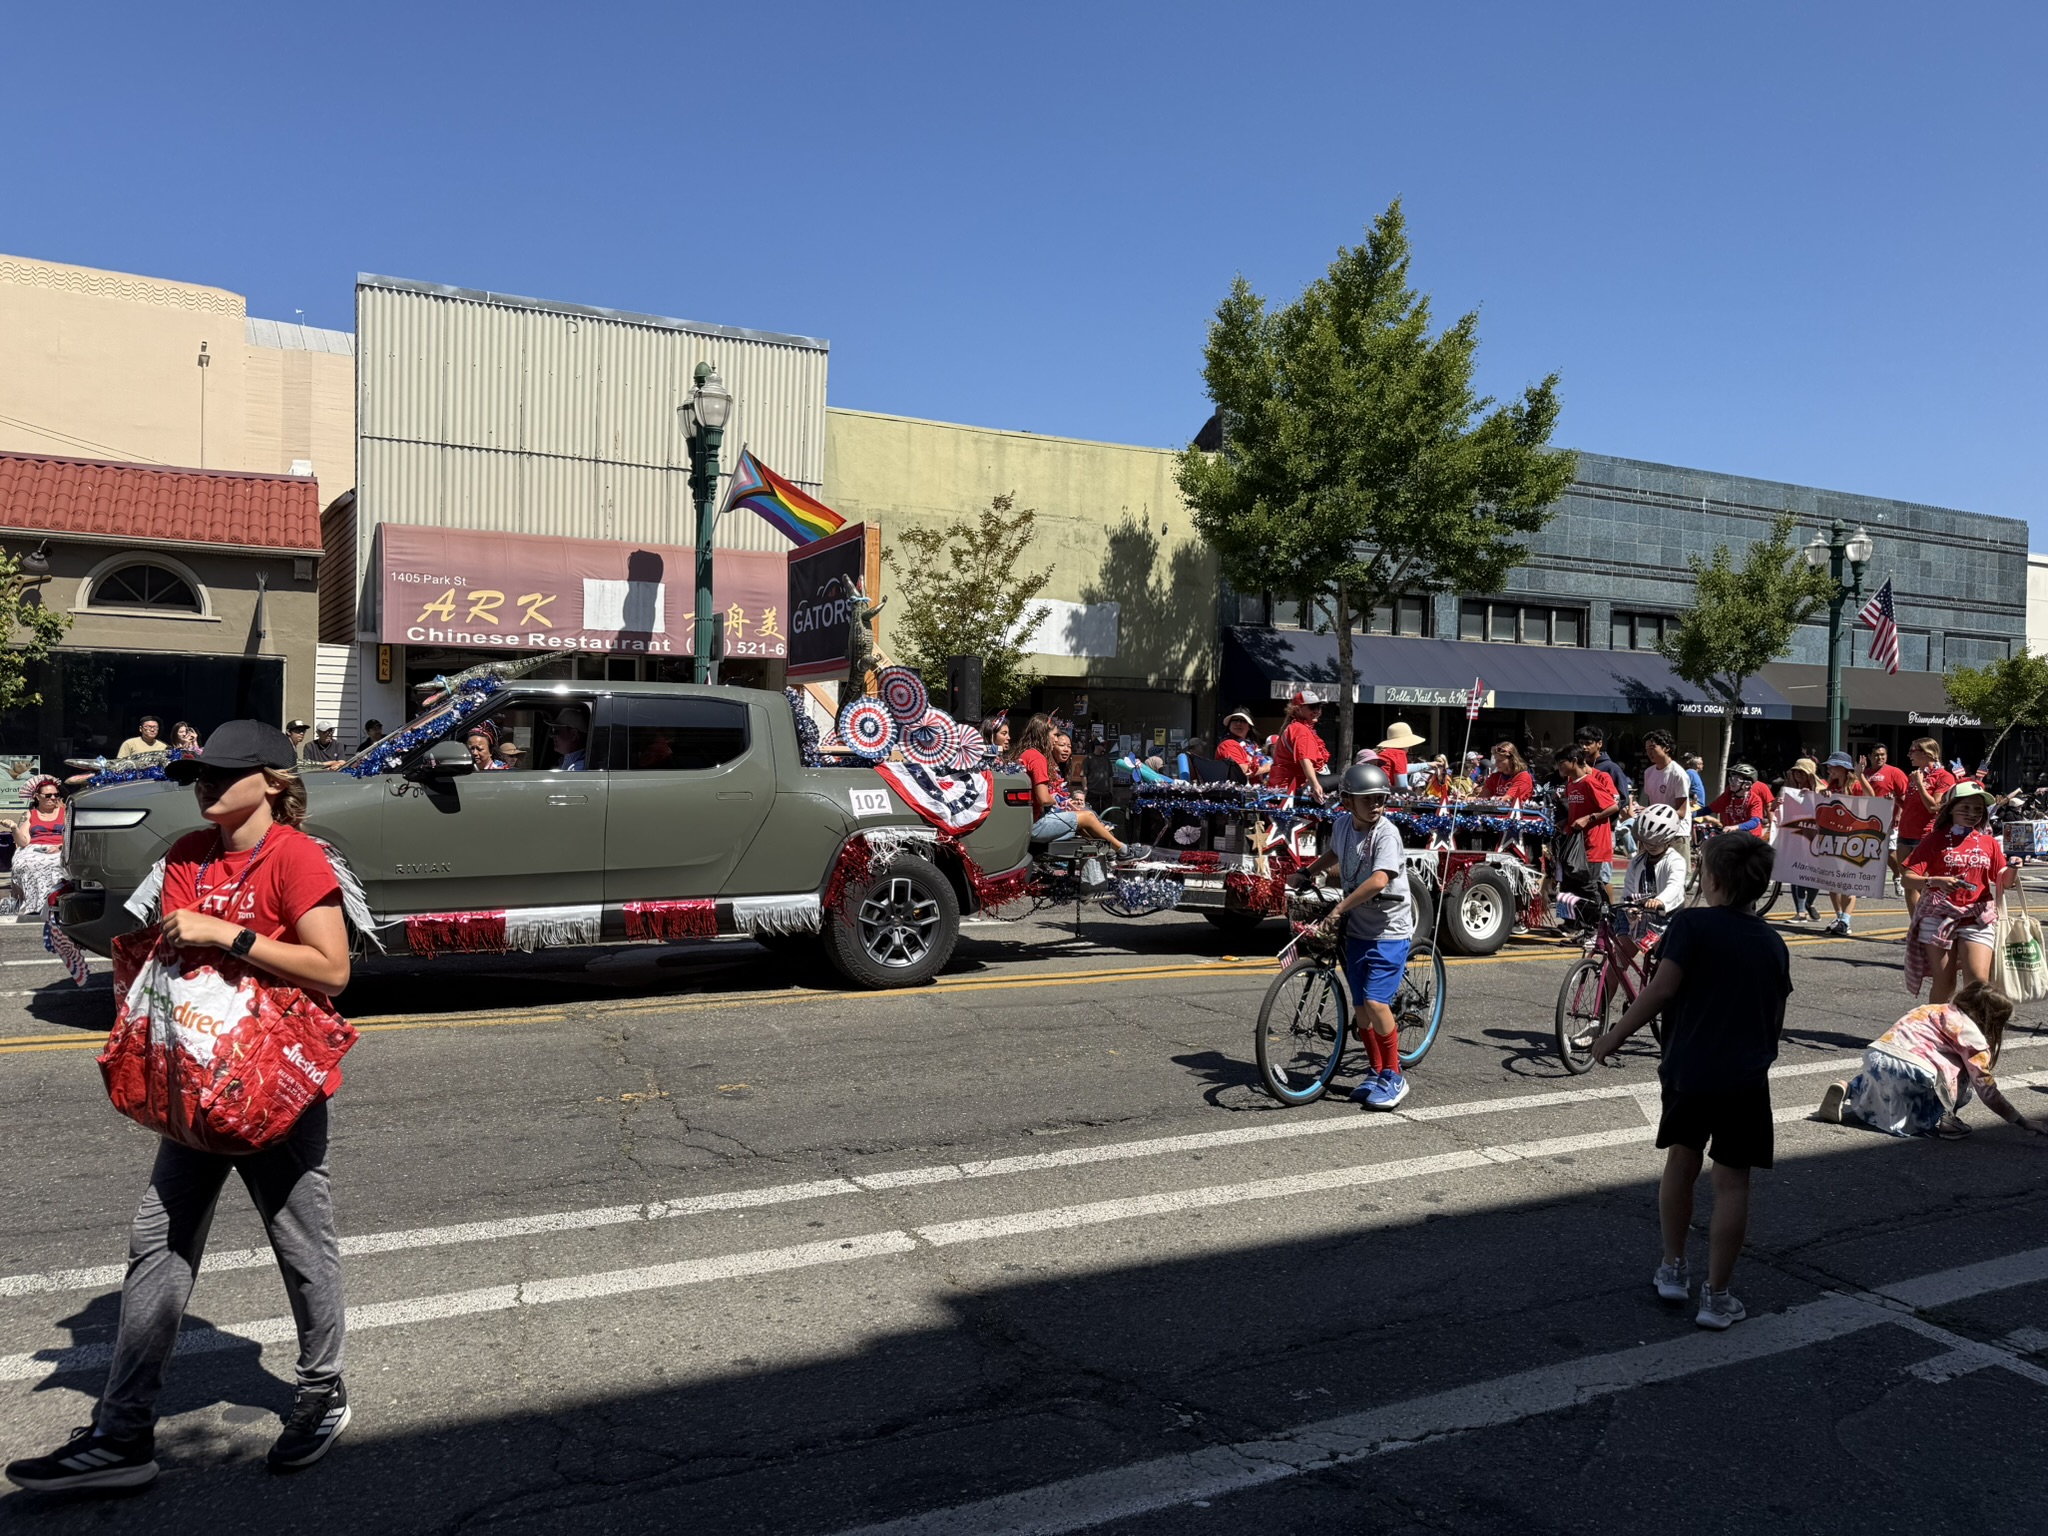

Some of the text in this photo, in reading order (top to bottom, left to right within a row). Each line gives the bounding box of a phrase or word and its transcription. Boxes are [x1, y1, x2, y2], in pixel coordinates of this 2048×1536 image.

[391, 572, 467, 586] 1405 Park St
[416, 588, 557, 628] ARK
[407, 627, 519, 645] Chinese
[528, 633, 671, 651] Restaurant
[1387, 687, 1411, 702] Bella
[1411, 689, 1431, 703] Nail
[1432, 690, 1447, 705] Spa
[1449, 691, 1456, 703] &
[1677, 703, 1702, 713] TOMO'S
[1751, 707, 1762, 715] SPA
[1959, 715, 1981, 726] Church
[855, 794, 886, 810] 102
[395, 862, 451, 874] RIVIAN
[1836, 870, 1857, 879] Swim
